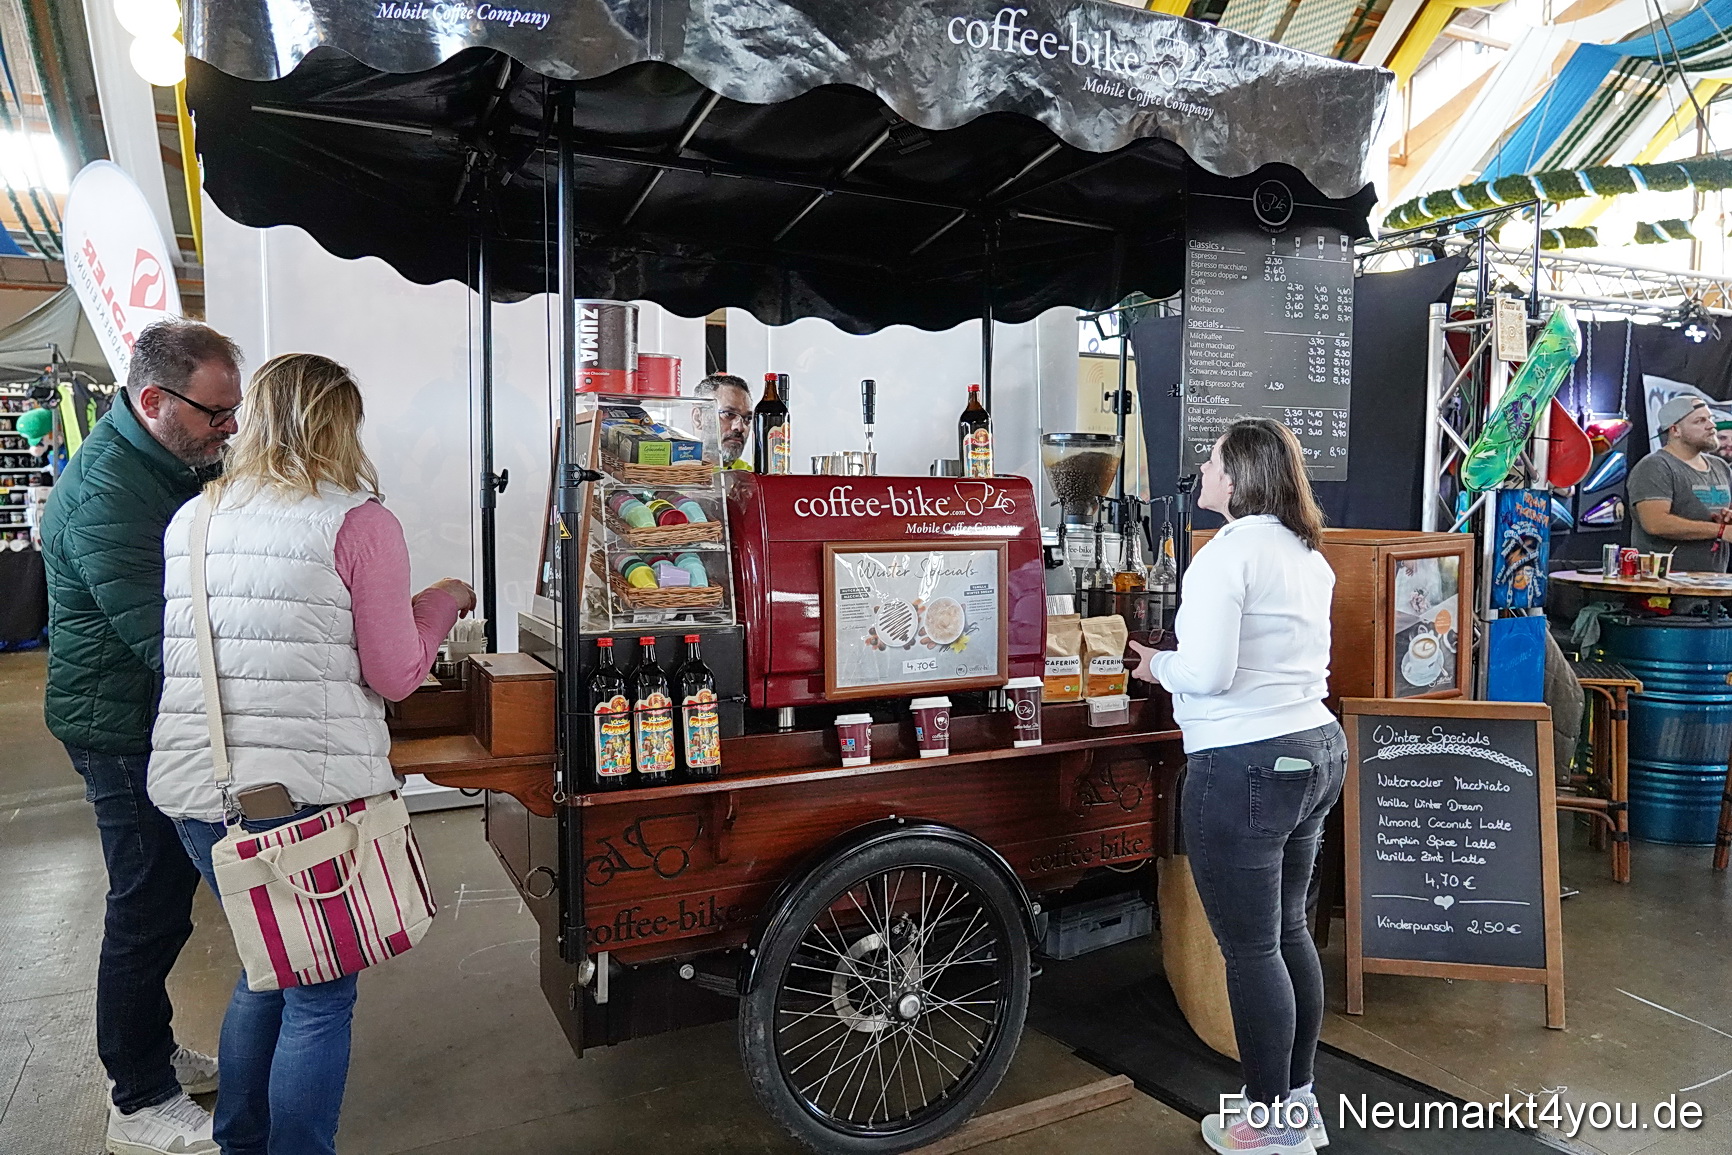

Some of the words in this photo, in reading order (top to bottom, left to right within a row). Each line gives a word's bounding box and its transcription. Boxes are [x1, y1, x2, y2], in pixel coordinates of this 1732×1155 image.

[376, 3, 429, 20] Mobile
[432, 3, 473, 24] Coffee
[477, 4, 550, 30] Company
[1082, 77, 1125, 99] Mobile
[1127, 85, 1161, 108] Coffee
[1164, 95, 1214, 121] Company
[1189, 240, 1219, 250] Classics
[1191, 252, 1217, 260] Espresso
[1265, 257, 1283, 266] 2,30
[1191, 260, 1217, 269] Espresso
[1218, 263, 1248, 271] macchiato
[1264, 266, 1285, 274] 2,60
[1190, 269, 1217, 278] Espresso
[1218, 272, 1238, 280] doppio
[1264, 274, 1286, 282] 3,60
[1190, 287, 1225, 296] Cappuccino
[1287, 283, 1304, 291] 2,70
[1190, 296, 1212, 304] Othello
[1190, 305, 1225, 313] Mochaccino
[1188, 318, 1219, 328] Specials
[579, 308, 599, 363] ZUMA
[1190, 332, 1222, 340] Milchkaffee
[1190, 350, 1219, 358] Mint-Choc
[1190, 359, 1230, 367] Karamell-Choc
[1231, 361, 1246, 369] Latte
[1205, 380, 1231, 388] Espresso
[1186, 395, 1230, 404] Non-Coffee
[1284, 408, 1302, 417] 3,30
[1333, 410, 1348, 419] 4,70
[1284, 418, 1304, 426] 3,30
[1332, 420, 1347, 429] 4,70
[905, 522, 940, 534] Mobile
[942, 522, 970, 536] Coffee
[857, 559, 910, 579] Winter
[1372, 724, 1421, 745] Winter
[1427, 726, 1490, 749] Specials
[1454, 776, 1511, 792] Macchiato
[1377, 796, 1409, 808] Vanilla
[1414, 798, 1442, 810] Winter
[1447, 800, 1483, 812] Dream
[1378, 814, 1421, 829] Almond
[1428, 816, 1472, 830] Coconut
[1479, 818, 1512, 831] Latte
[1377, 833, 1419, 848] Pumpkin
[1426, 835, 1457, 848] Spice
[1465, 836, 1496, 849] Latte
[1029, 831, 1144, 873] coffee-bike
[1376, 850, 1415, 862] Vanilla
[1421, 851, 1444, 863] Zimt
[1451, 851, 1486, 865] Latte
[1377, 915, 1453, 933] Kinderpunsch
